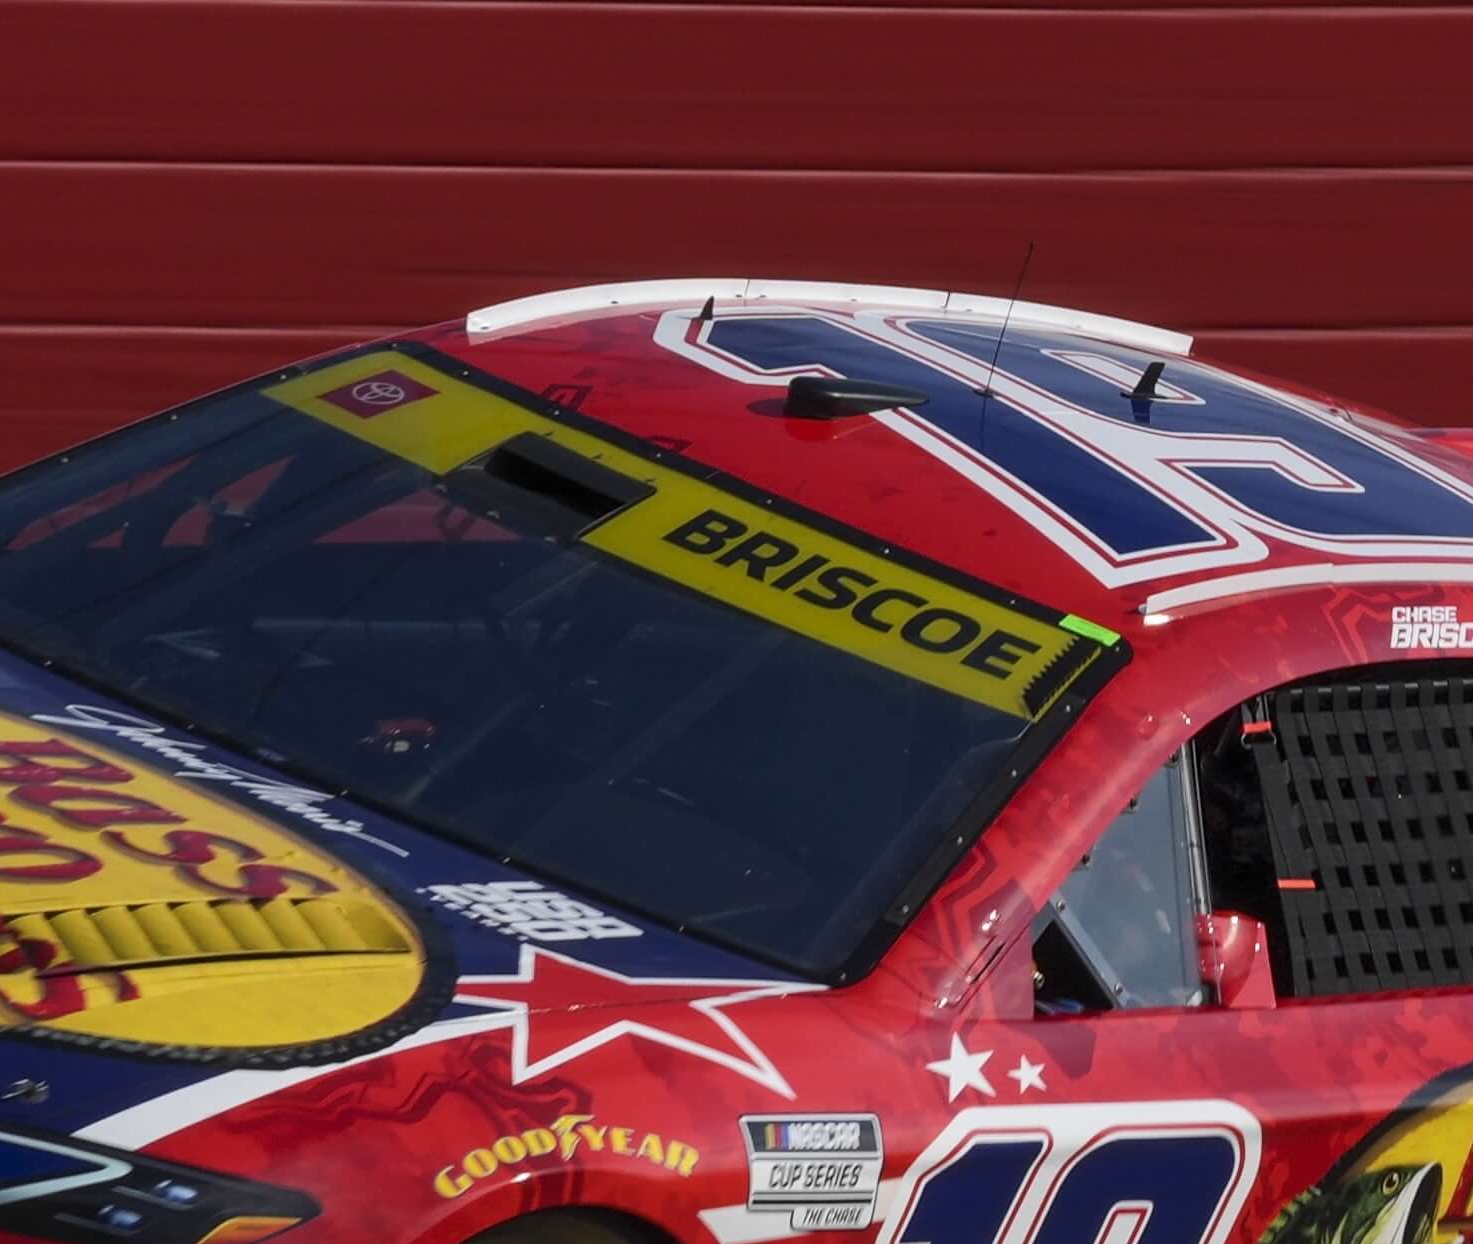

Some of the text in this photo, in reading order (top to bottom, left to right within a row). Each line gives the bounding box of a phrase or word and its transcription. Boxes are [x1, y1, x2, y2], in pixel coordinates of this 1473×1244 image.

[661, 507, 1049, 682] BRISCOE
[1391, 606, 1458, 623] CHASE
[788, 1121, 861, 1150] NASCAR
[434, 1114, 700, 1199] GOODYEAR
[768, 1163, 863, 1189] CUP SERIES
[802, 1207, 864, 1225] THE CHASE
